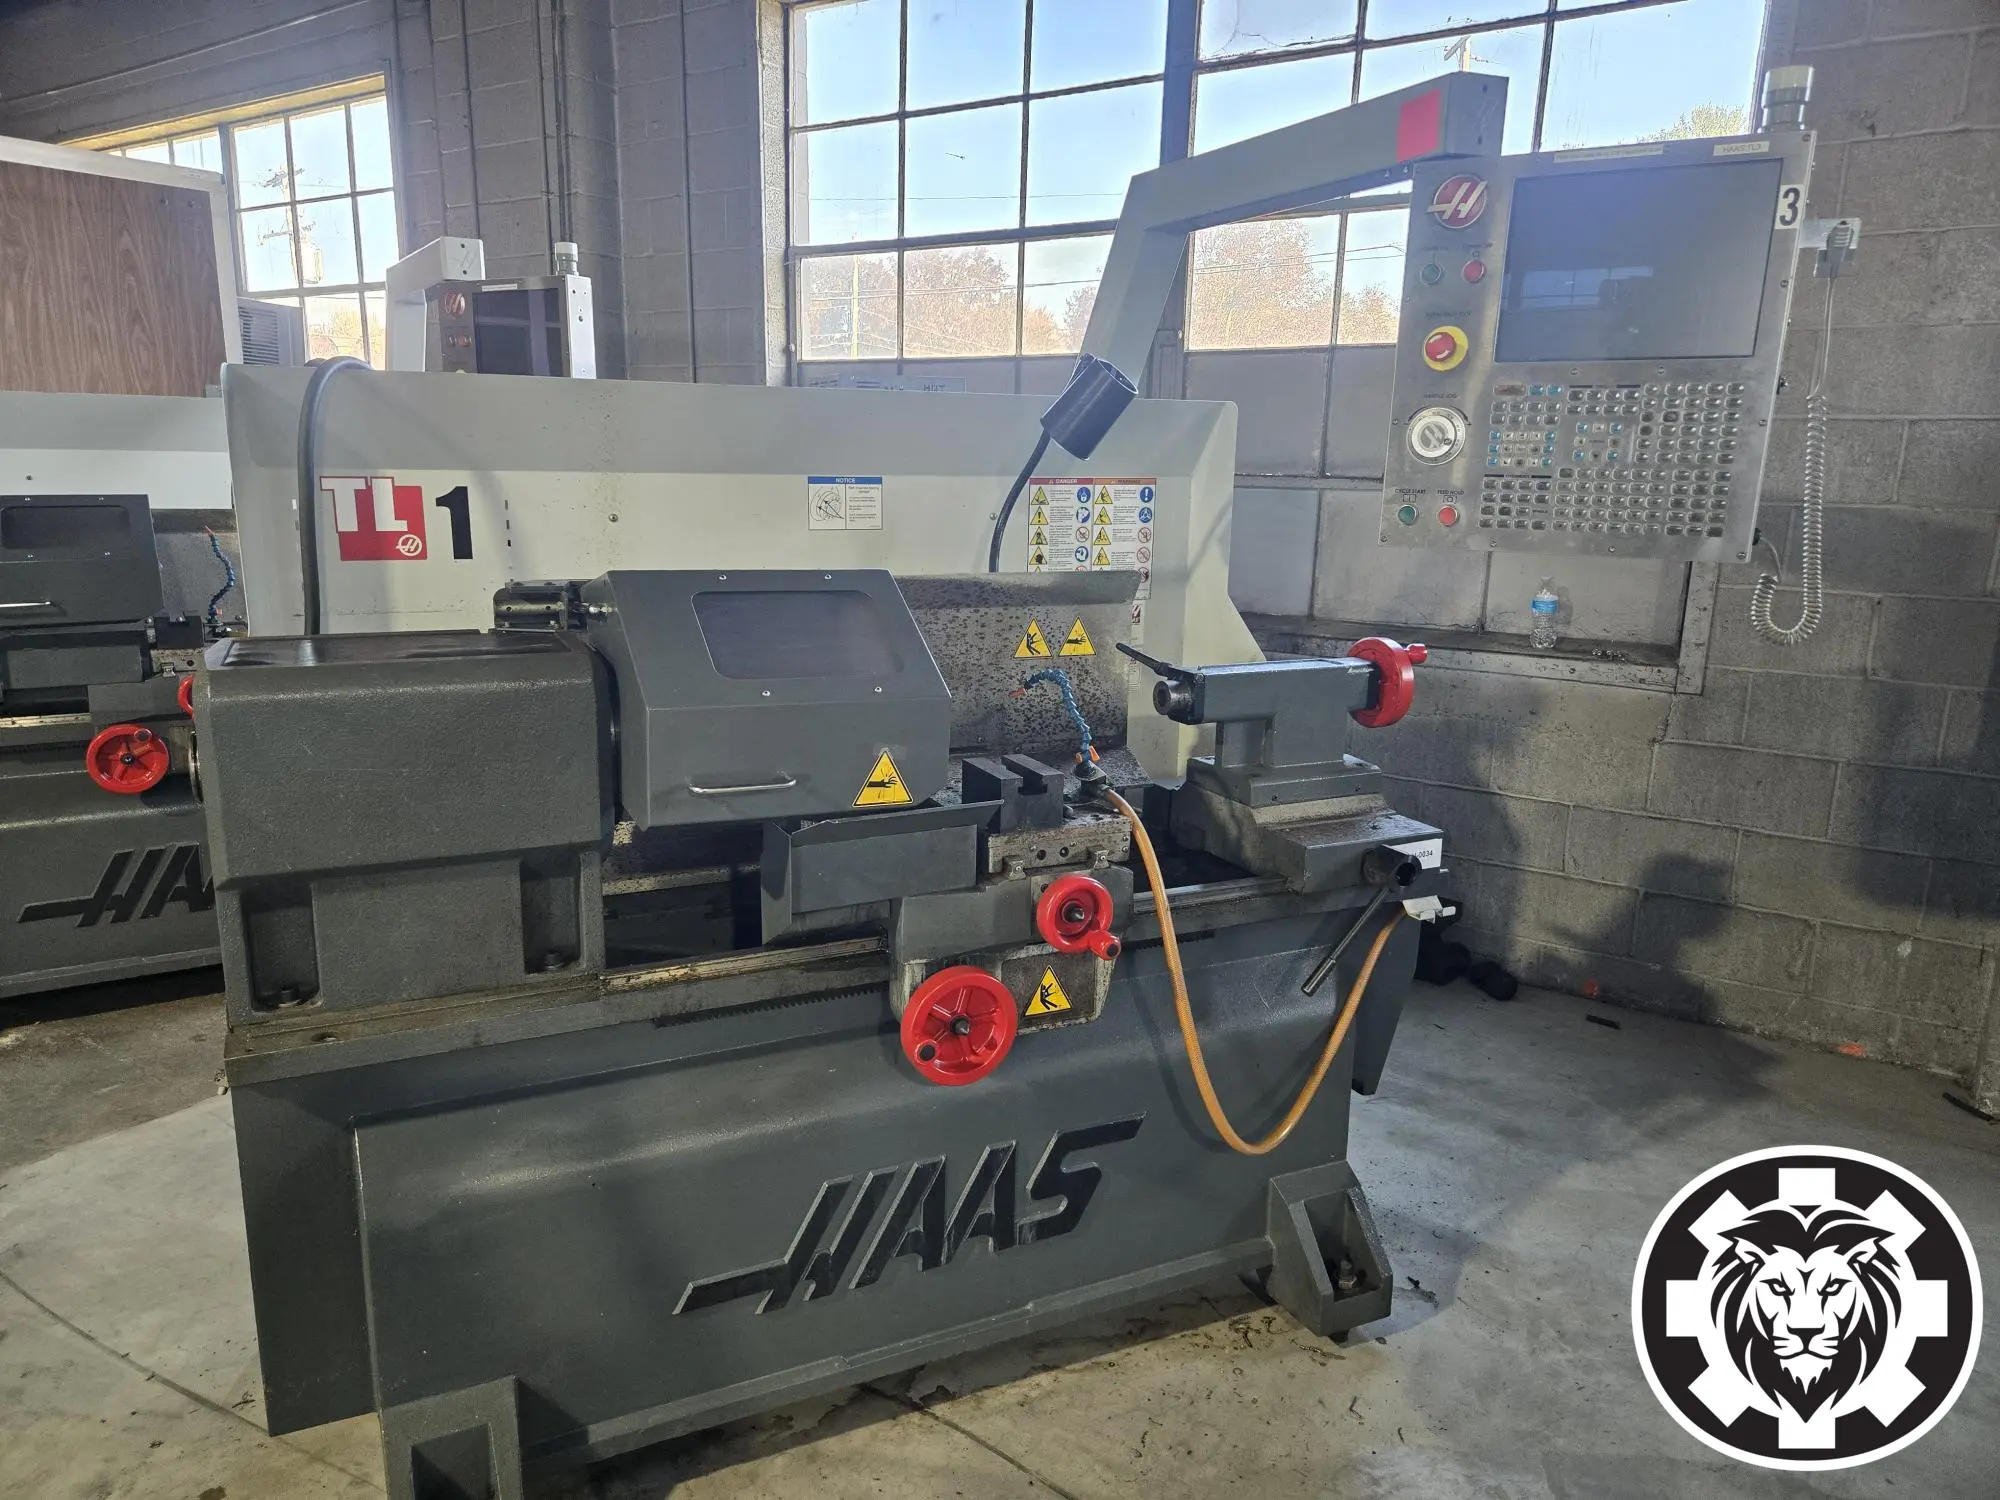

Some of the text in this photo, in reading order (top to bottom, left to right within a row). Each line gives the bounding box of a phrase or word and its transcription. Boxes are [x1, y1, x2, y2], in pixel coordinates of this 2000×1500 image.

[1779, 187, 1801, 227] 3
[320, 476, 473, 560] TL 1
[16, 841, 216, 928] HA
[671, 1110, 1147, 1316] HAAS
